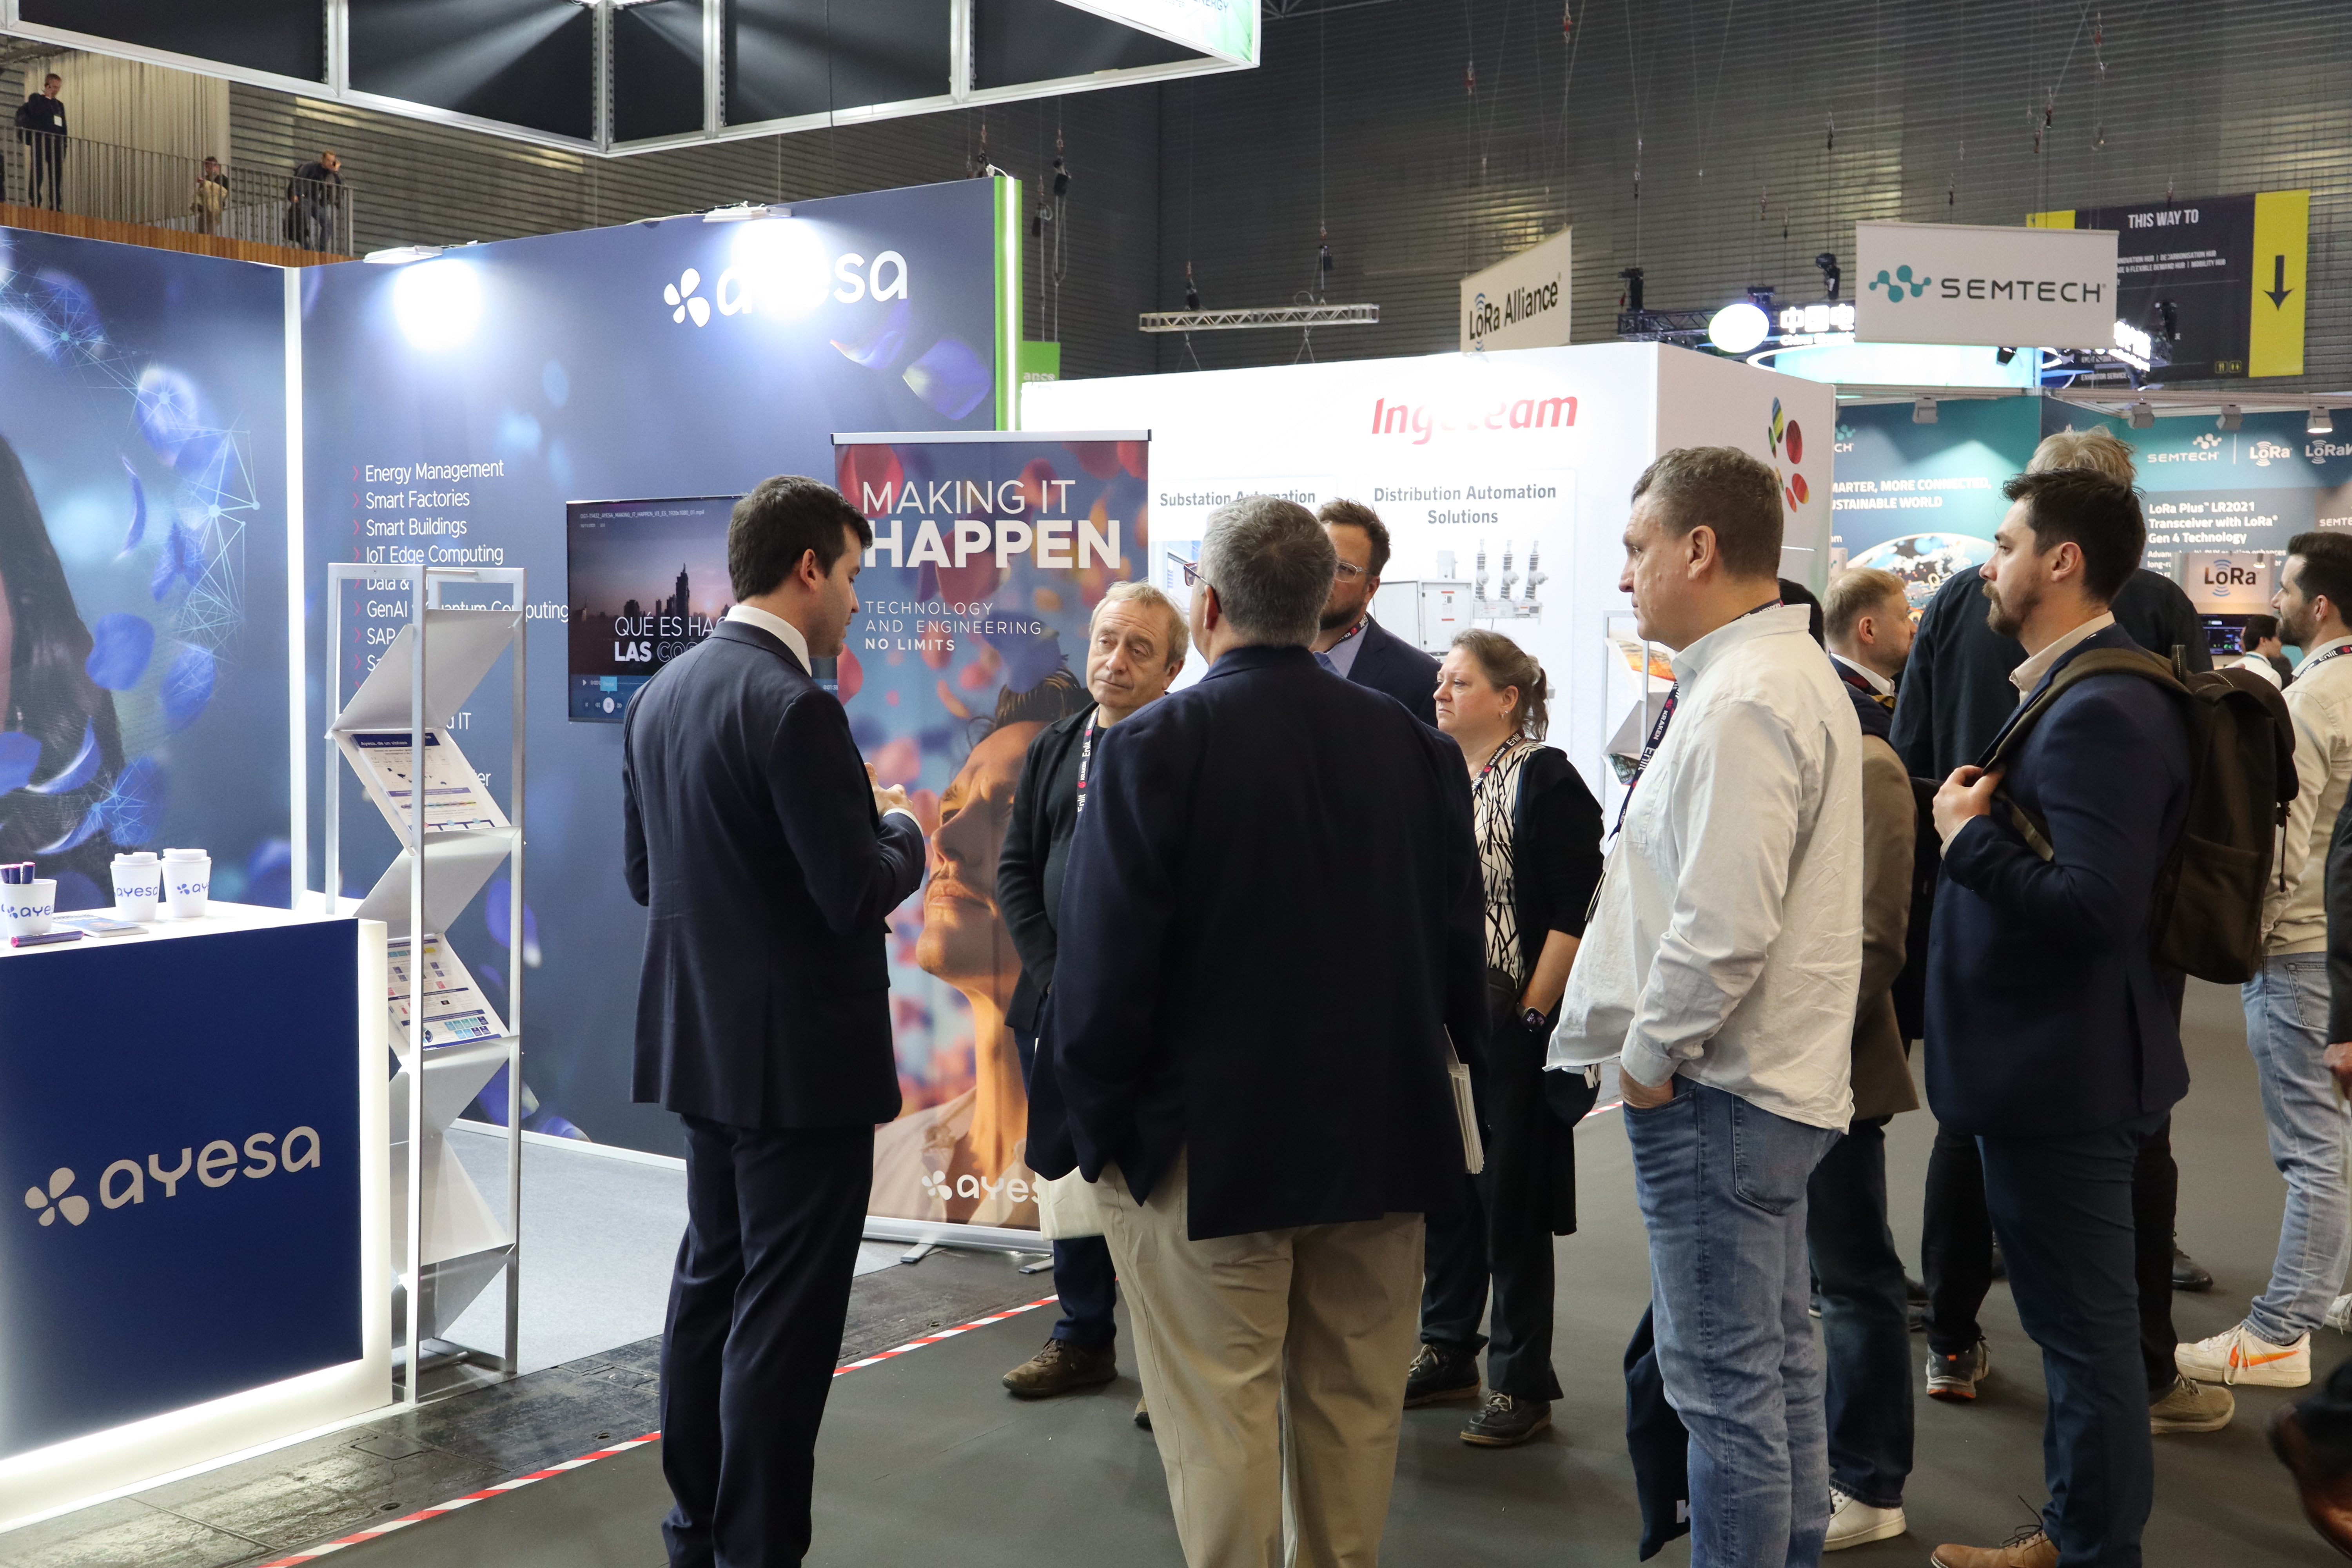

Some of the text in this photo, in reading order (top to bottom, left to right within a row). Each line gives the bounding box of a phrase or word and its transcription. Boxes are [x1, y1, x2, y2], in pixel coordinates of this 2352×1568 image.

[2128, 209, 2199, 229] THIS WAY TO
[717, 250, 907, 316] asa
[1941, 278, 2100, 303] SEMTECH
[1470, 303, 1500, 340] LoRa
[1372, 396, 1578, 445] Ingeam
[2147, 452, 2218, 463] SEMTECH
[365, 459, 504, 485] Energy Management
[1374, 484, 1556, 502] Distribution Automation
[1832, 477, 1992, 493] MARTER, MORE CONNECTED,
[366, 489, 470, 509] Smart Factories
[863, 480, 1076, 515] MAKING IT
[1160, 491, 1231, 506] Substation
[1831, 496, 1943, 510] USTAINABLE WORLD
[1428, 509, 1498, 524] Solutions
[2149, 503, 2177, 514] LoRa
[2211, 501, 2255, 512] LR2021
[366, 517, 467, 538] Smart Buildings
[2148, 517, 2213, 528] Transceiver
[2215, 516, 2242, 527] with
[2319, 517, 2352, 526] SEMTE
[864, 520, 1121, 569] HAPPEN
[2148, 532, 2247, 544] Gen 4 Technology
[366, 544, 504, 566] IoT Edge Computing
[2205, 567, 2256, 585] LoRa
[367, 601, 408, 618] GenAI
[866, 601, 993, 615] TECHNOLOGY
[615, 612, 654, 636] QUÉ
[660, 616, 682, 637] ES
[866, 620, 1041, 635] AND ENGINEERING
[367, 628, 396, 645] SAP
[865, 638, 955, 651] NO LIMITS
[615, 641, 652, 662] LAS
[459, 712, 472, 730] IT
[1653, 710, 1668, 740] KRAKEN
[1082, 740, 1091, 757] Enlit
[1505, 733, 1522, 746] Enlit
[1489, 747, 1506, 766] KRAKEN
[1472, 777, 1484, 791] nlit
[20, 904, 53, 918] ayes
[100, 1126, 320, 1209] ayesa
[957, 1174, 1038, 1203] ayes
